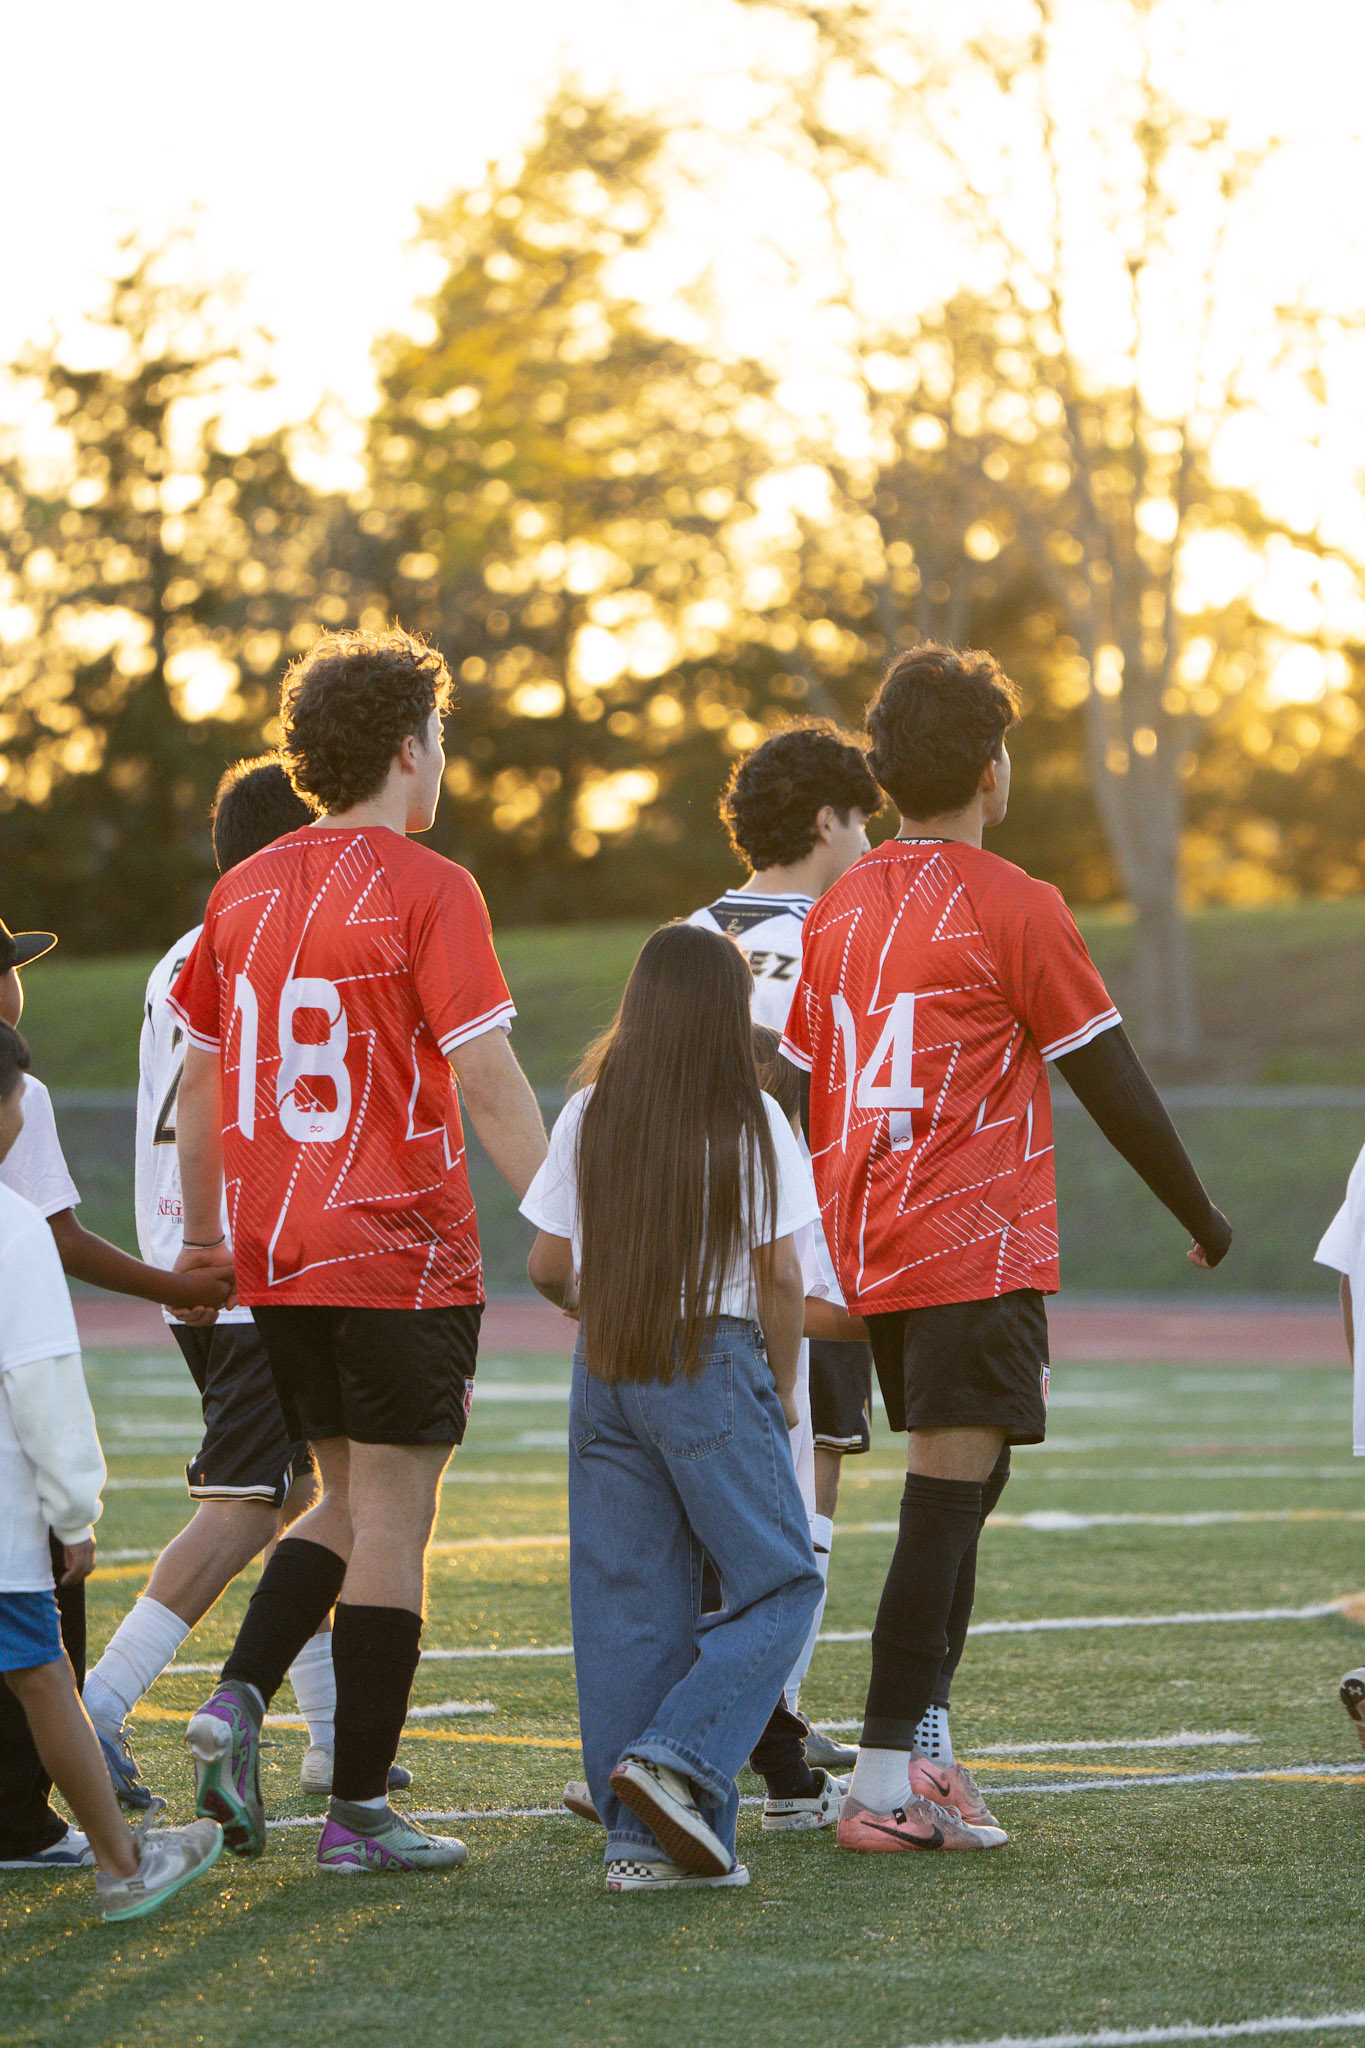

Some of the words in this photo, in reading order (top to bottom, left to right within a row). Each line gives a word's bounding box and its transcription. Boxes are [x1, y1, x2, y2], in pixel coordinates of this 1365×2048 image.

[746, 950, 799, 981] EZ
[234, 973, 352, 1143] 18
[829, 992, 925, 1155] 14
[157, 1196, 184, 1217] REG
